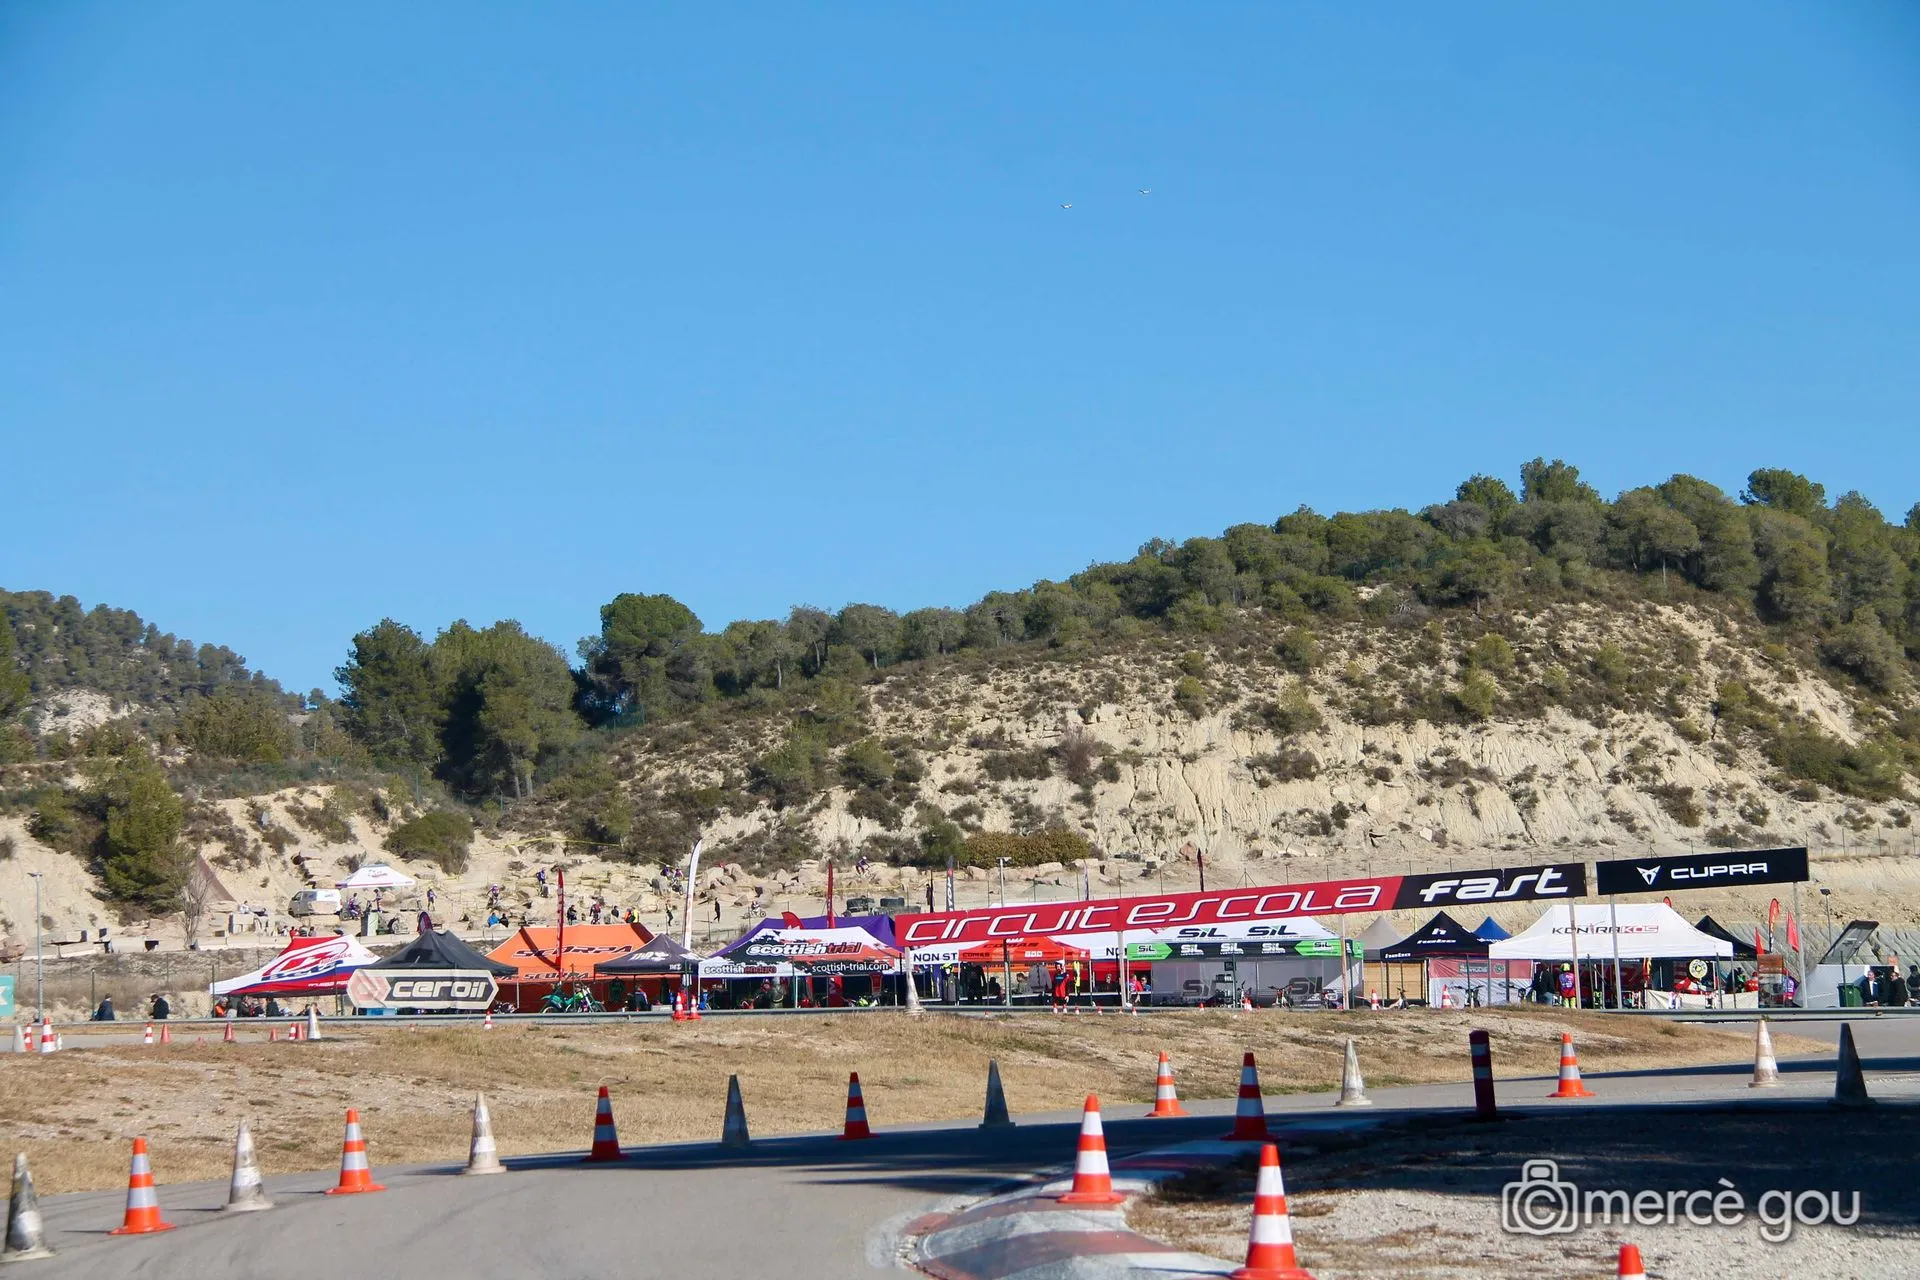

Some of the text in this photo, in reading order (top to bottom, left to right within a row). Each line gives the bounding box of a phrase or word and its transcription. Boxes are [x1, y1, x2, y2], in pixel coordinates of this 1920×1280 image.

[1671, 862, 1768, 880] CUPRA
[905, 867, 1569, 941] circuit escola fast
[913, 952, 940, 962] NON
[812, 961, 889, 974] scottish-trial.com
[392, 981, 489, 999] ceroil
